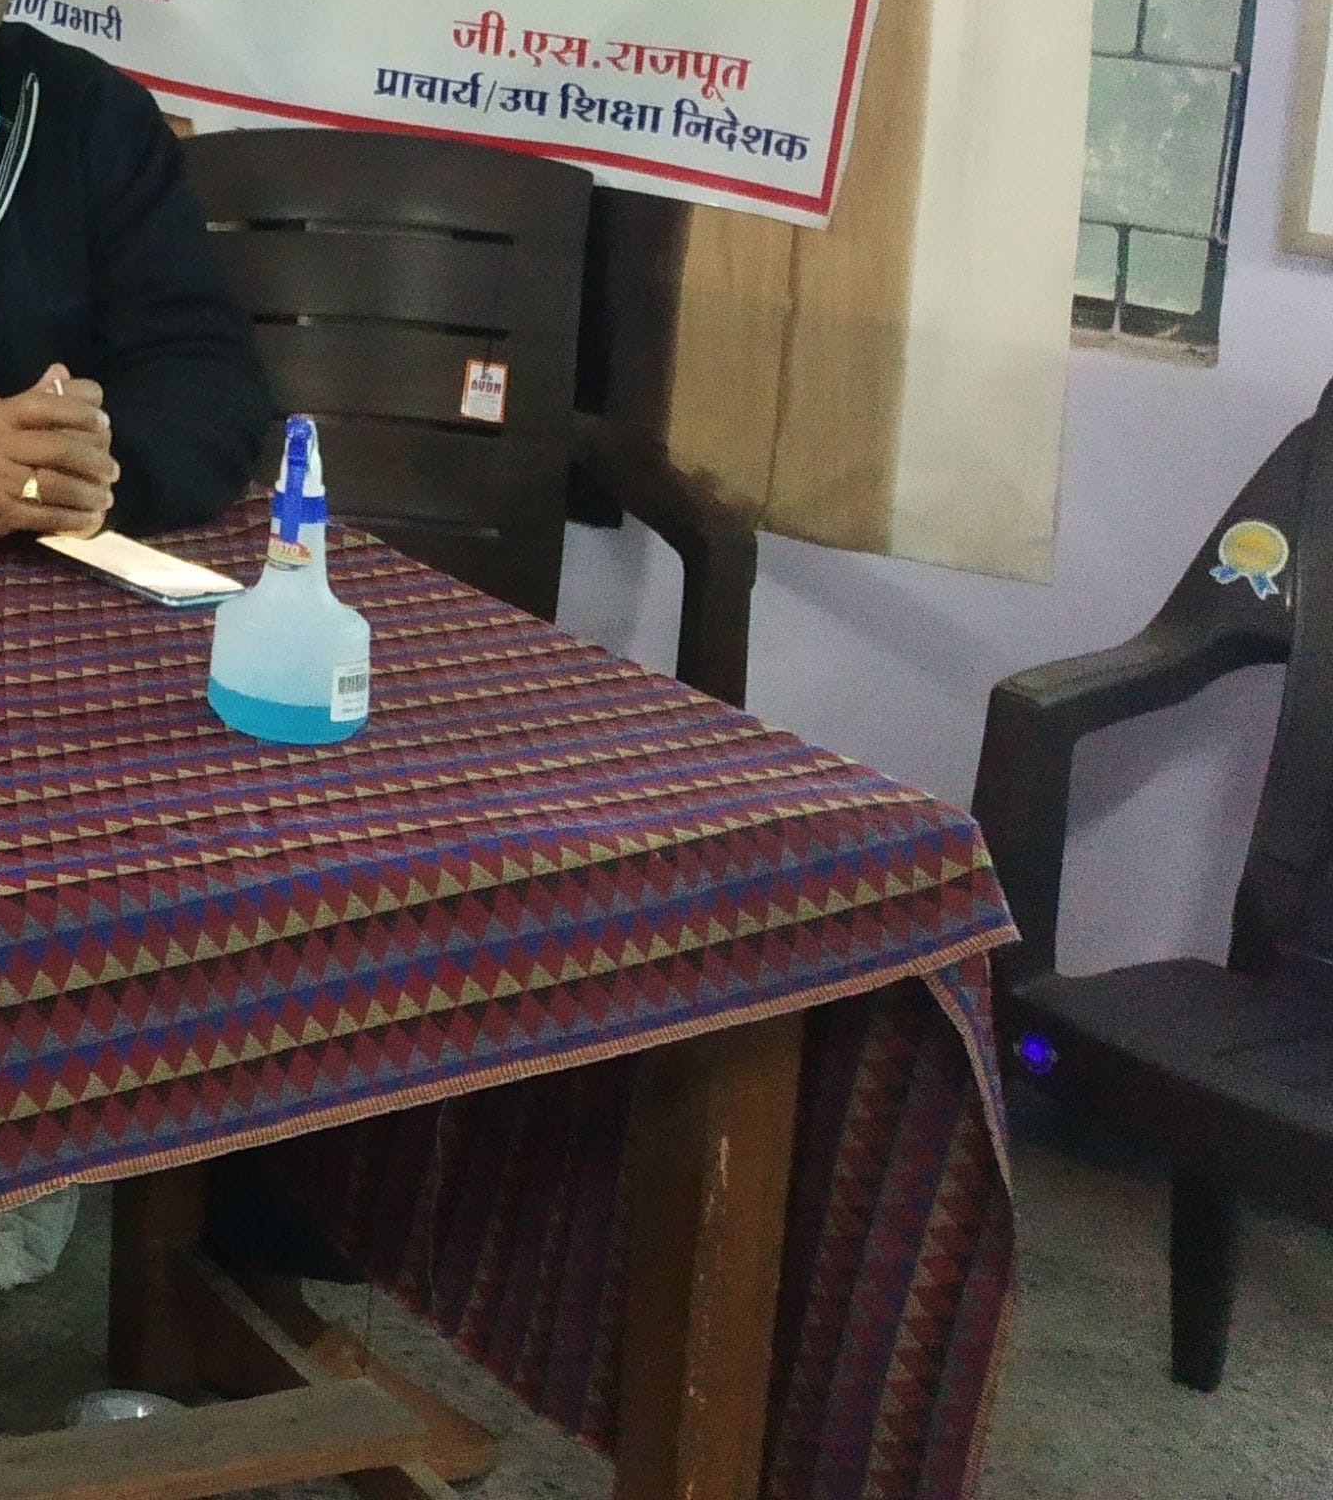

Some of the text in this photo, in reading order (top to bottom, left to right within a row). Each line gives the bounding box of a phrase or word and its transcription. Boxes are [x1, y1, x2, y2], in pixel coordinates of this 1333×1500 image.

[50, 0, 123, 42] प्रभारी
[559, 83, 666, 135] शिक्षा
[672, 98, 811, 164] निदेशक
